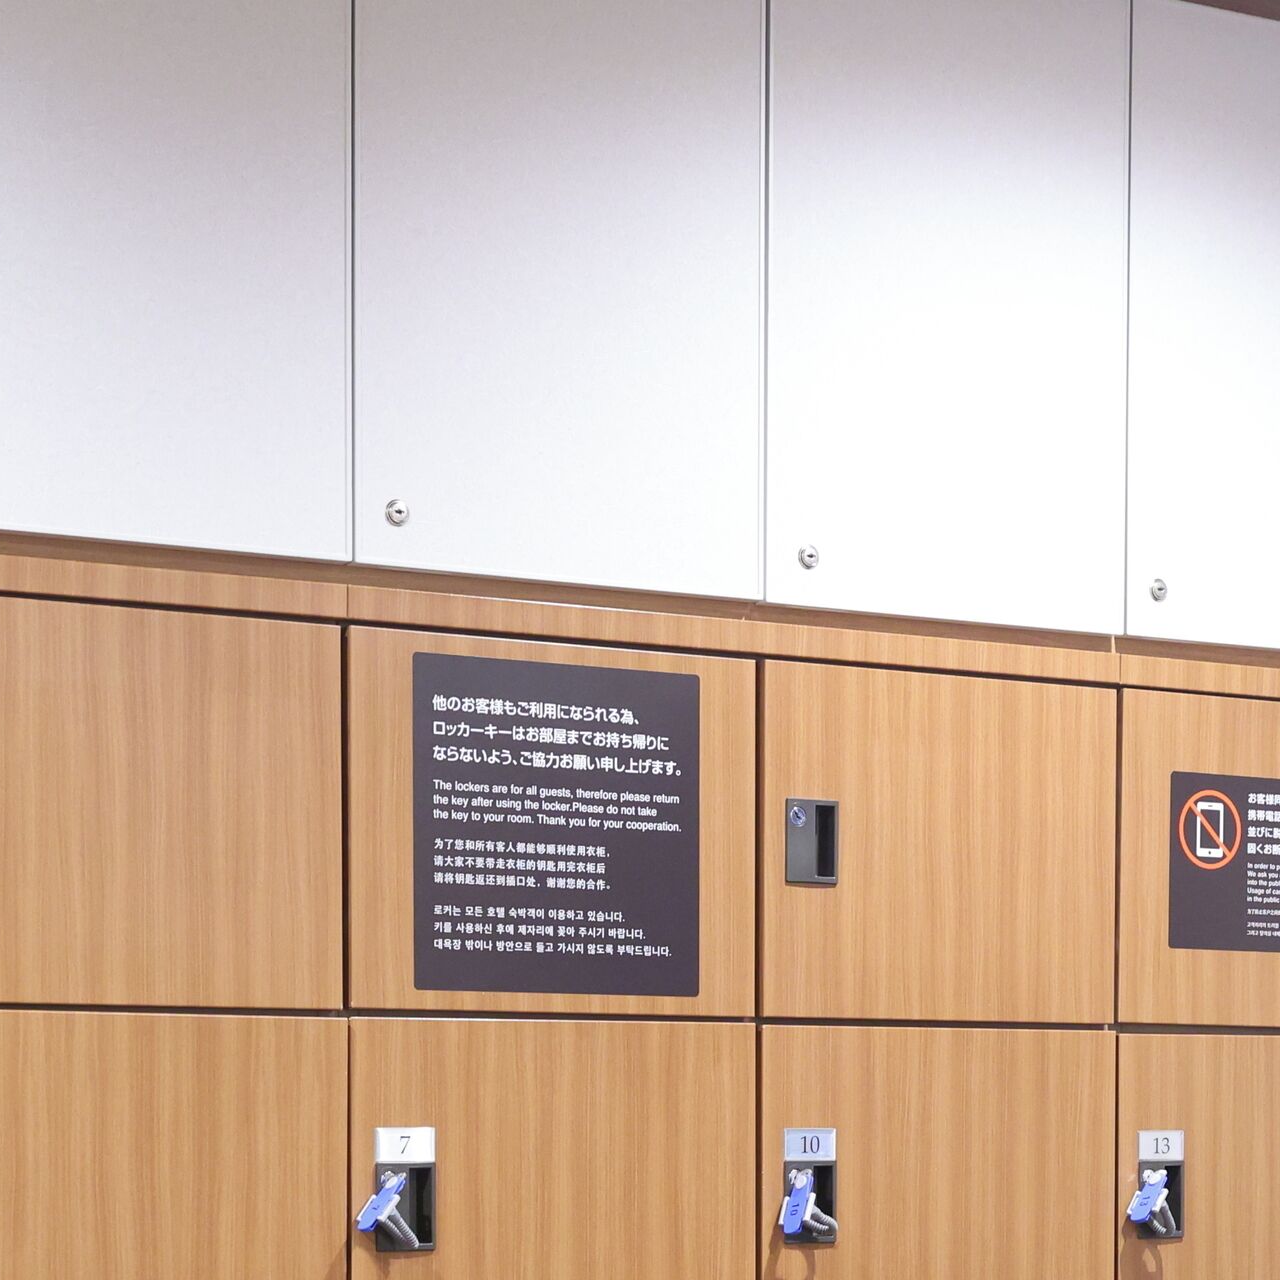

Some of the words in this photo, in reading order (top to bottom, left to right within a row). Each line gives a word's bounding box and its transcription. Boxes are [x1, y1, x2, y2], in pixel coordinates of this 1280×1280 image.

[432, 694, 639, 725] 他のお客様もご利用になられる為、
[433, 721, 669, 750] ロッカーキーはお部屋までお持ち帰りに
[433, 745, 681, 776] ならないよう、ご協力お願い申し上げます。
[433, 779, 452, 790] The
[455, 781, 490, 793] lockers
[492, 785, 508, 794] are
[510, 784, 524, 794] for
[526, 785, 537, 795] all
[539, 788, 573, 799] guests,
[576, 788, 618, 800] therefore
[620, 791, 651, 803] please
[653, 794, 680, 804] return
[433, 794, 449, 805] the
[451, 795, 469, 808] key
[471, 796, 493, 807] after
[496, 798, 522, 811] using
[524, 799, 539, 810] the
[542, 800, 604, 814] locker.Please
[606, 804, 618, 814] do
[621, 806, 635, 815] not
[637, 806, 657, 817] take
[433, 808, 449, 819] the
[451, 809, 469, 822] key
[471, 811, 481, 821] to
[483, 813, 505, 824] your
[507, 815, 534, 824] room.
[537, 814, 566, 825] Thank
[568, 818, 586, 828] you
[588, 817, 601, 827] for
[603, 820, 624, 830] your
[626, 821, 681, 832] cooperation.
[434, 905, 461, 916] 로커는
[465, 906, 483, 917] 모든
[508, 907, 544, 919] 숙박객이
[548, 909, 584, 921] 이용하고
[587, 910, 625, 922] 있습니다.
[456, 922, 492, 934] 사용하신
[496, 923, 514, 935] 후에
[518, 925, 553, 936] 제자리에
[578, 927, 604, 938] 주시기
[608, 928, 646, 940] 바랍니다.
[434, 938, 461, 950] 대욕장
[465, 939, 493, 951] 밖이나
[496, 940, 532, 952] 방안으로
[557, 942, 584, 954] 가시지
[400, 1135, 411, 1154] 7
[801, 1136, 820, 1154] 10
[1154, 1137, 1170, 1154] 13
